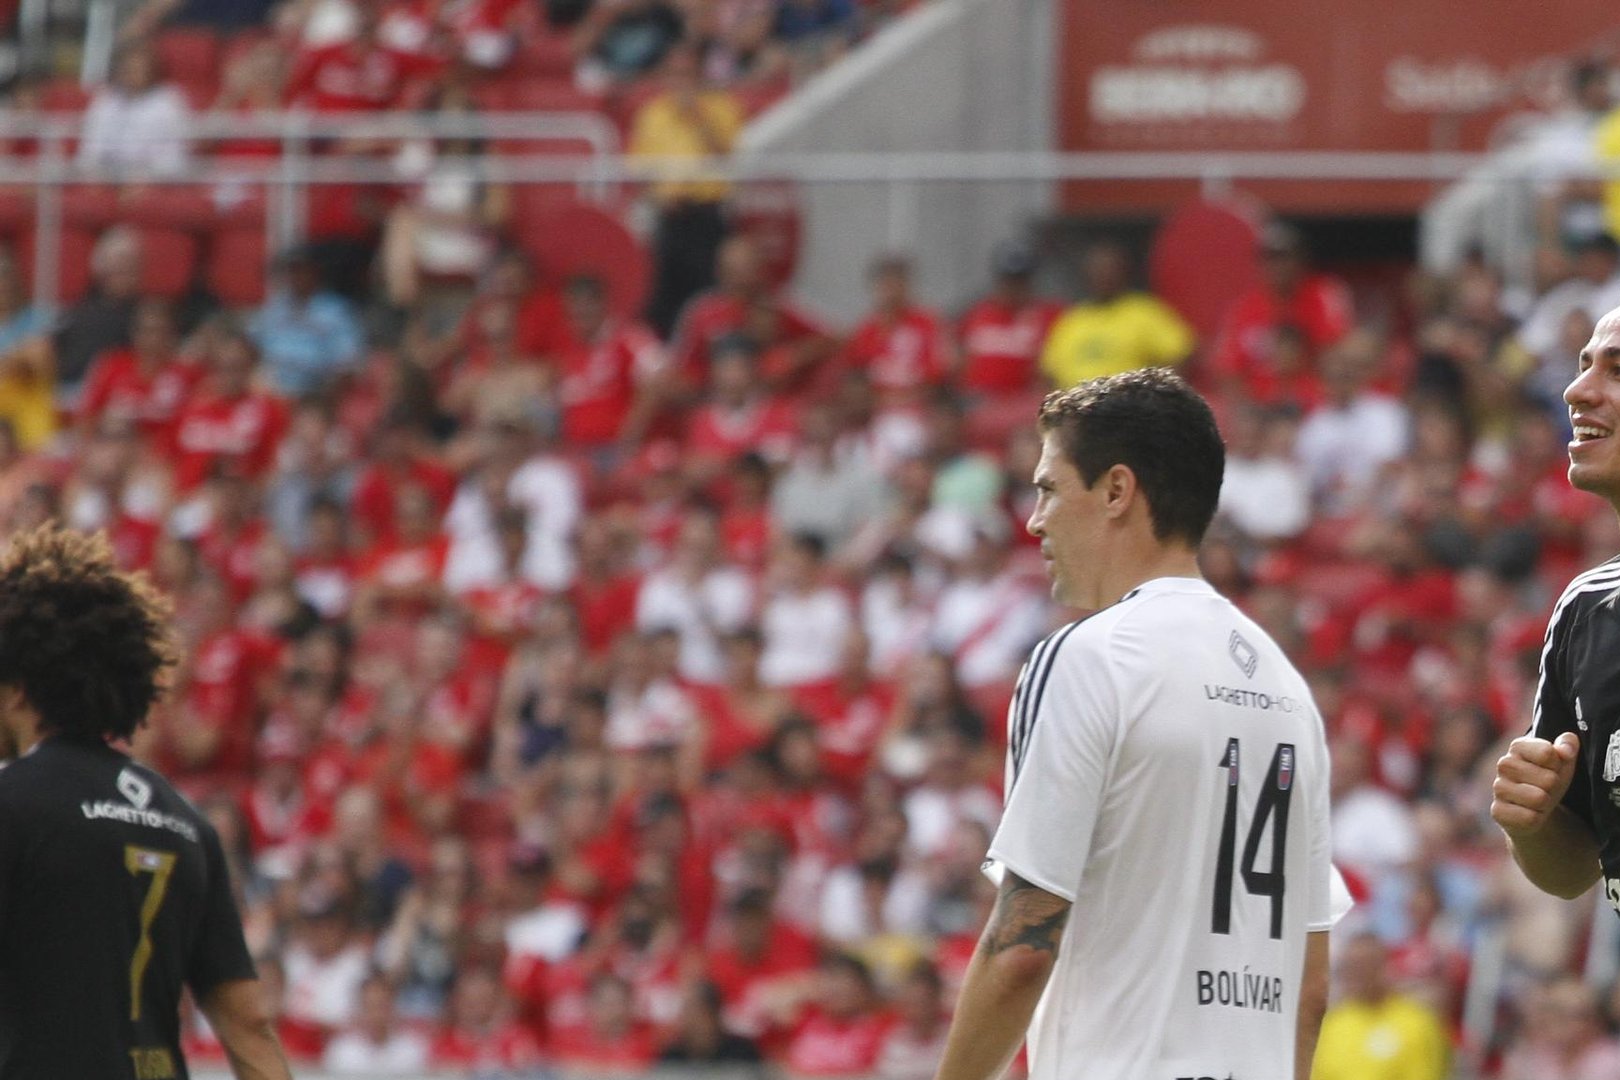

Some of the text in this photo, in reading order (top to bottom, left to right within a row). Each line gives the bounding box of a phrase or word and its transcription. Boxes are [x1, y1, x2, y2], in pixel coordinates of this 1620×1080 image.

[1210, 737, 1296, 940] 14
[124, 845, 178, 1021] 7
[1196, 965, 1283, 1014] BOLÍVAR
